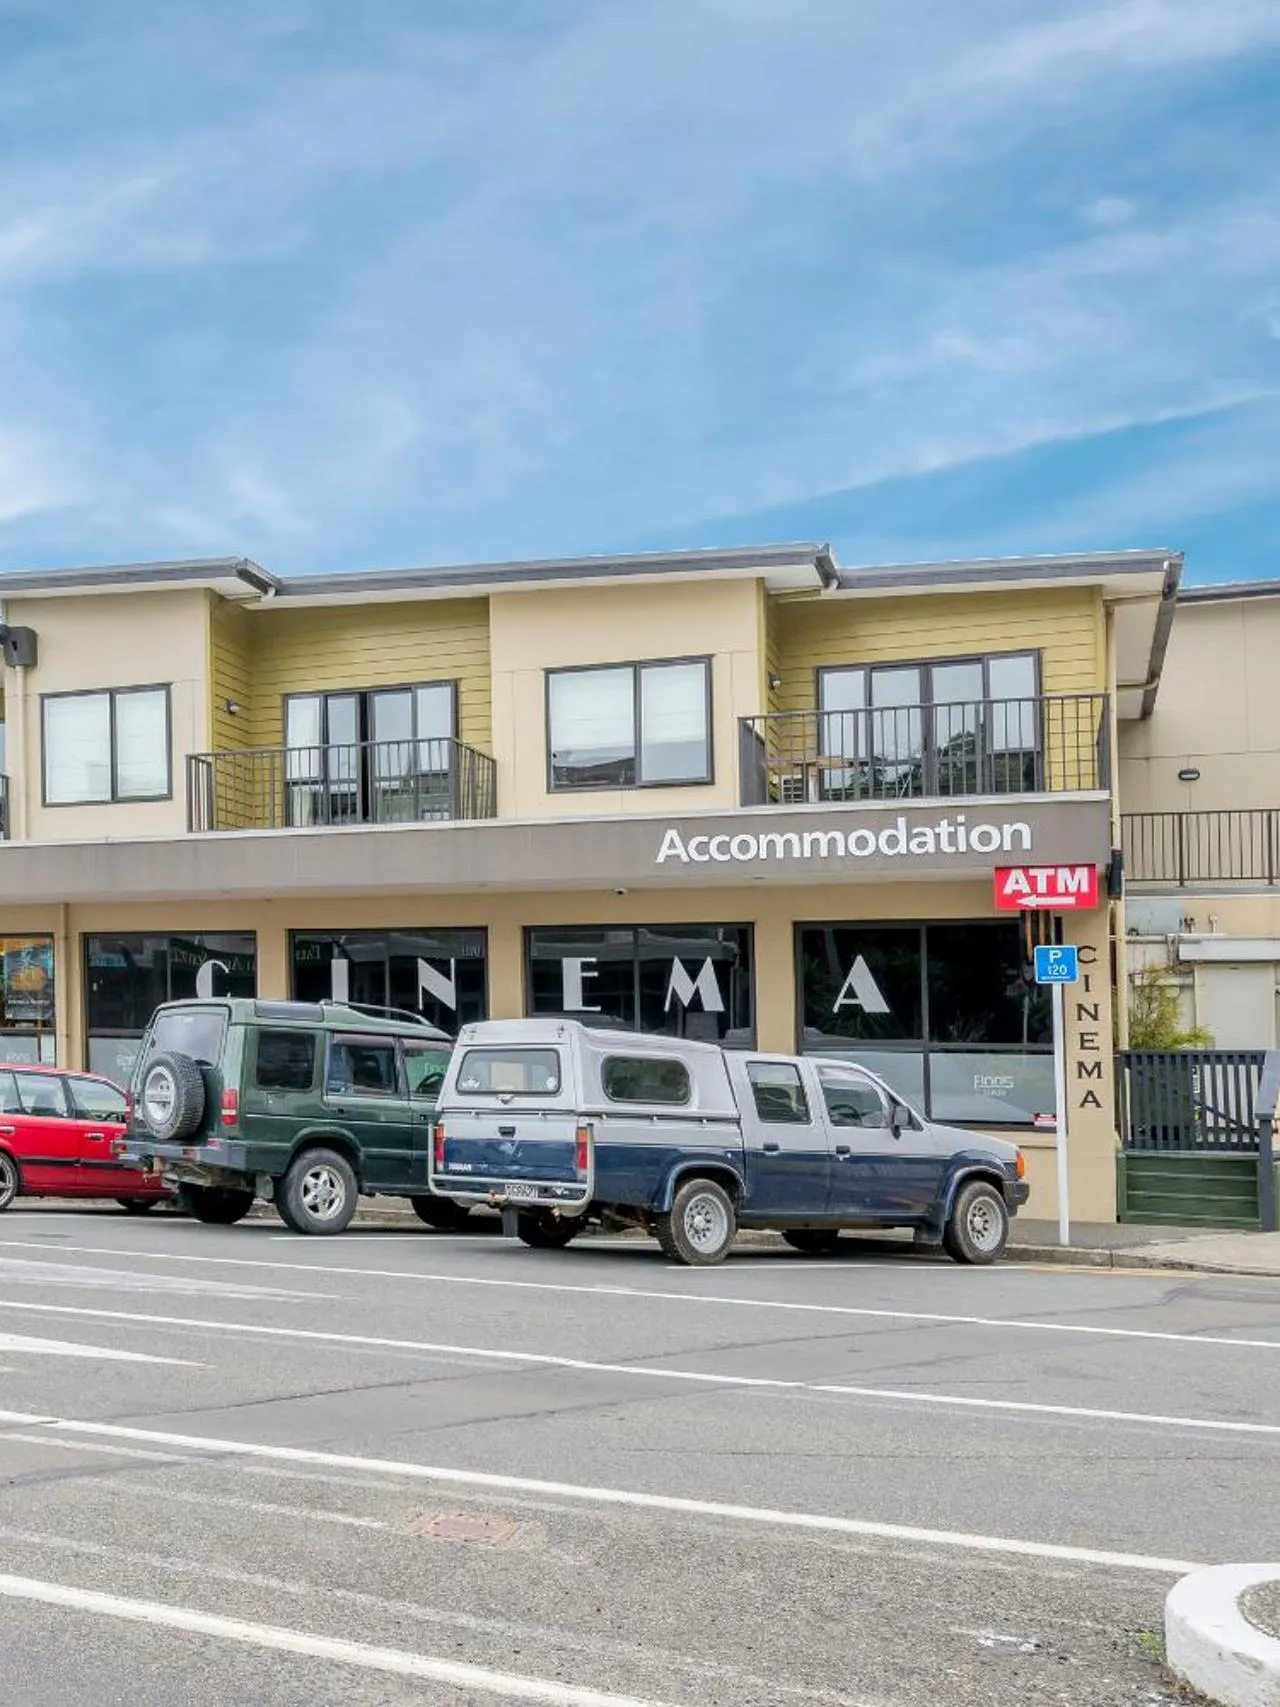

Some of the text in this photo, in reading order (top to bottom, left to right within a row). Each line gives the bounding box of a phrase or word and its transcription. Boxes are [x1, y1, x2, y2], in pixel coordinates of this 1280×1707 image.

[656, 815, 1032, 864] Accommodation
[1002, 867, 1089, 895] ATM
[1047, 963, 1068, 976] 120
[1049, 949, 1062, 963] P
[1077, 945, 1103, 1109] CINEMA
